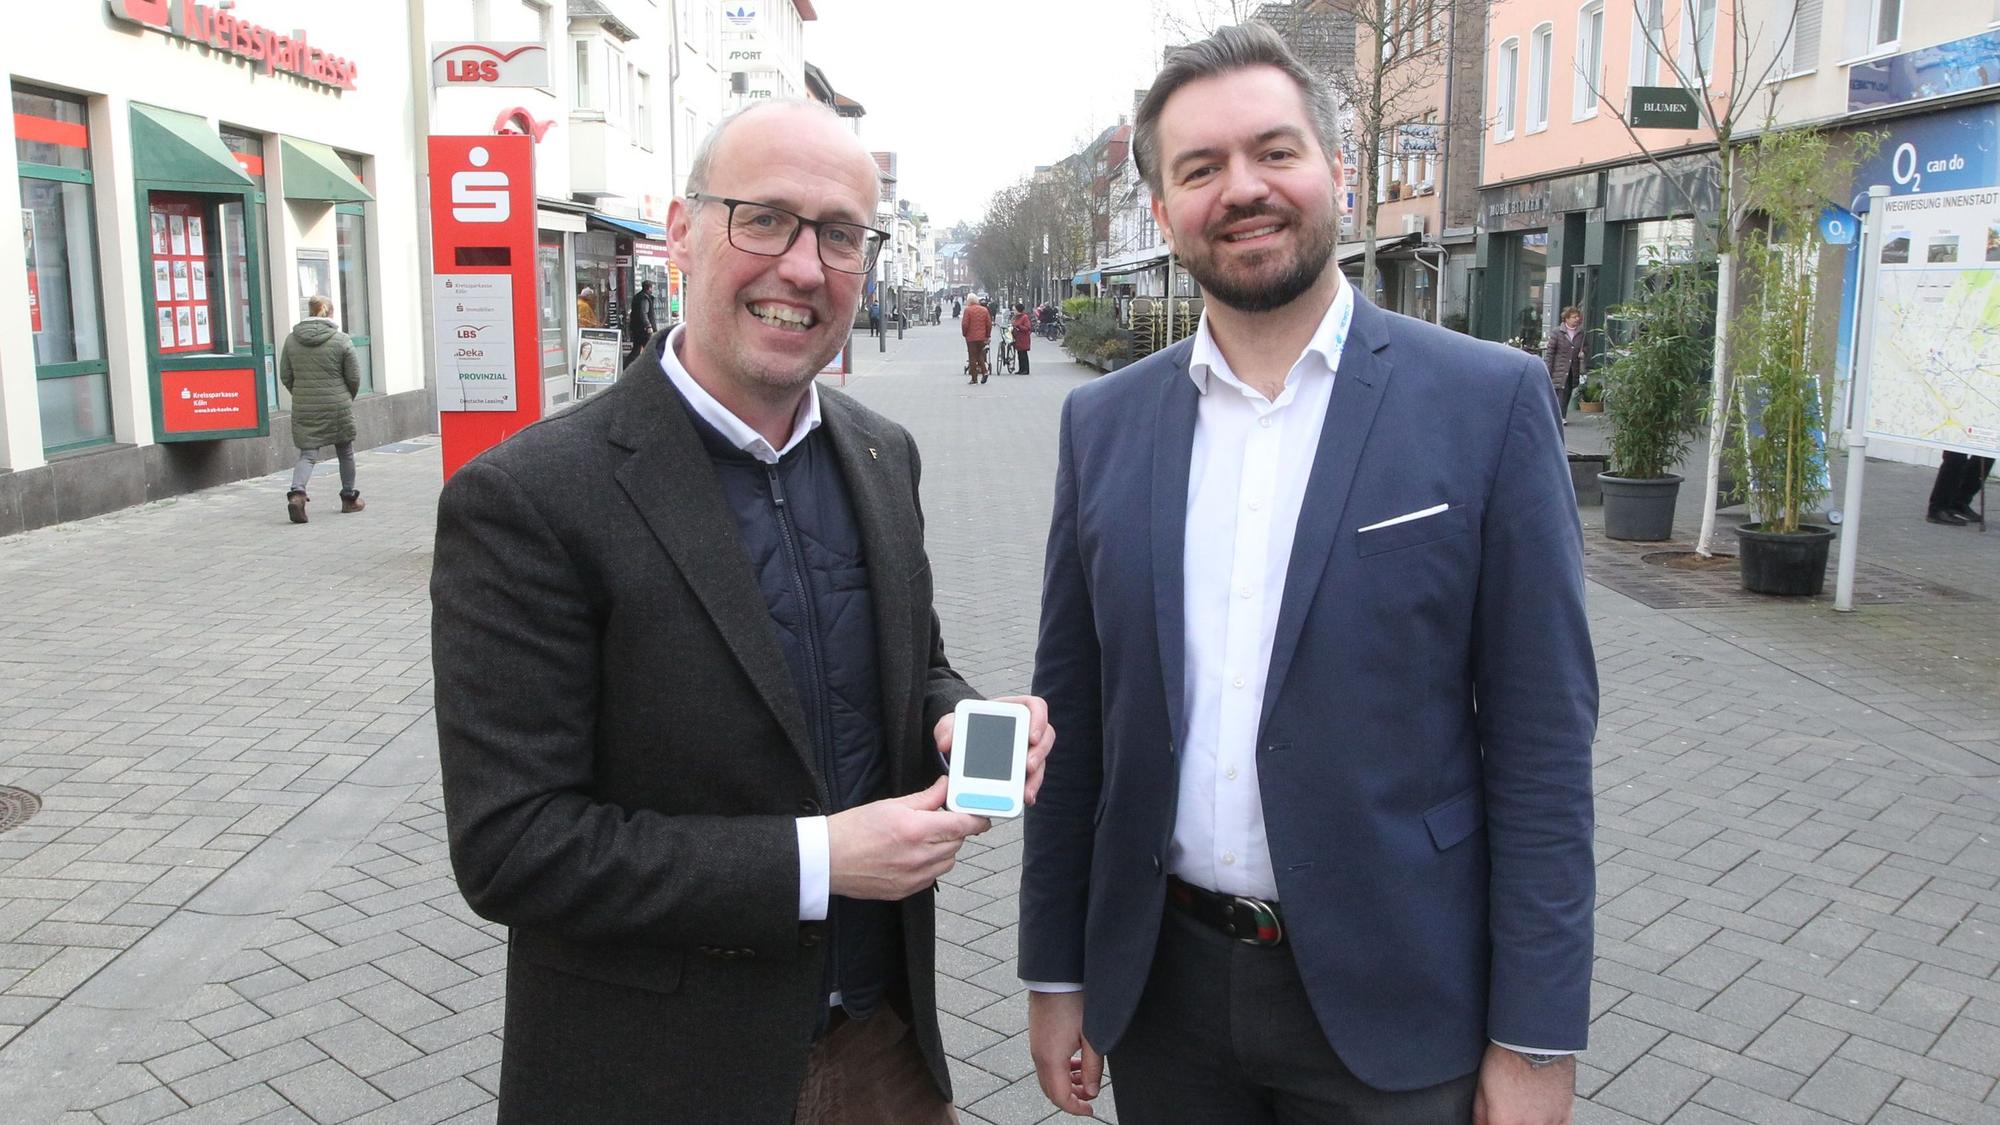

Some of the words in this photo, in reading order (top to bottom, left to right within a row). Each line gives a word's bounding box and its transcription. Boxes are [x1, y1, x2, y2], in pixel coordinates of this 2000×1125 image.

[180, 0, 357, 90] Kreissparkasse
[729, 51, 762, 60] SPORT
[446, 60, 499, 81] LBS
[1643, 103, 1687, 113] BLUMEN
[1927, 159, 1947, 173] can
[1949, 153, 1965, 171] do
[1885, 197, 1941, 212] WEGWEISUNG
[1943, 193, 1999, 208] INNENSTADT
[457, 330, 477, 339] LBS
[458, 348, 484, 357] Deka
[459, 373, 508, 381] PROVINZIAL
[193, 391, 239, 399] Kreissparkasse
